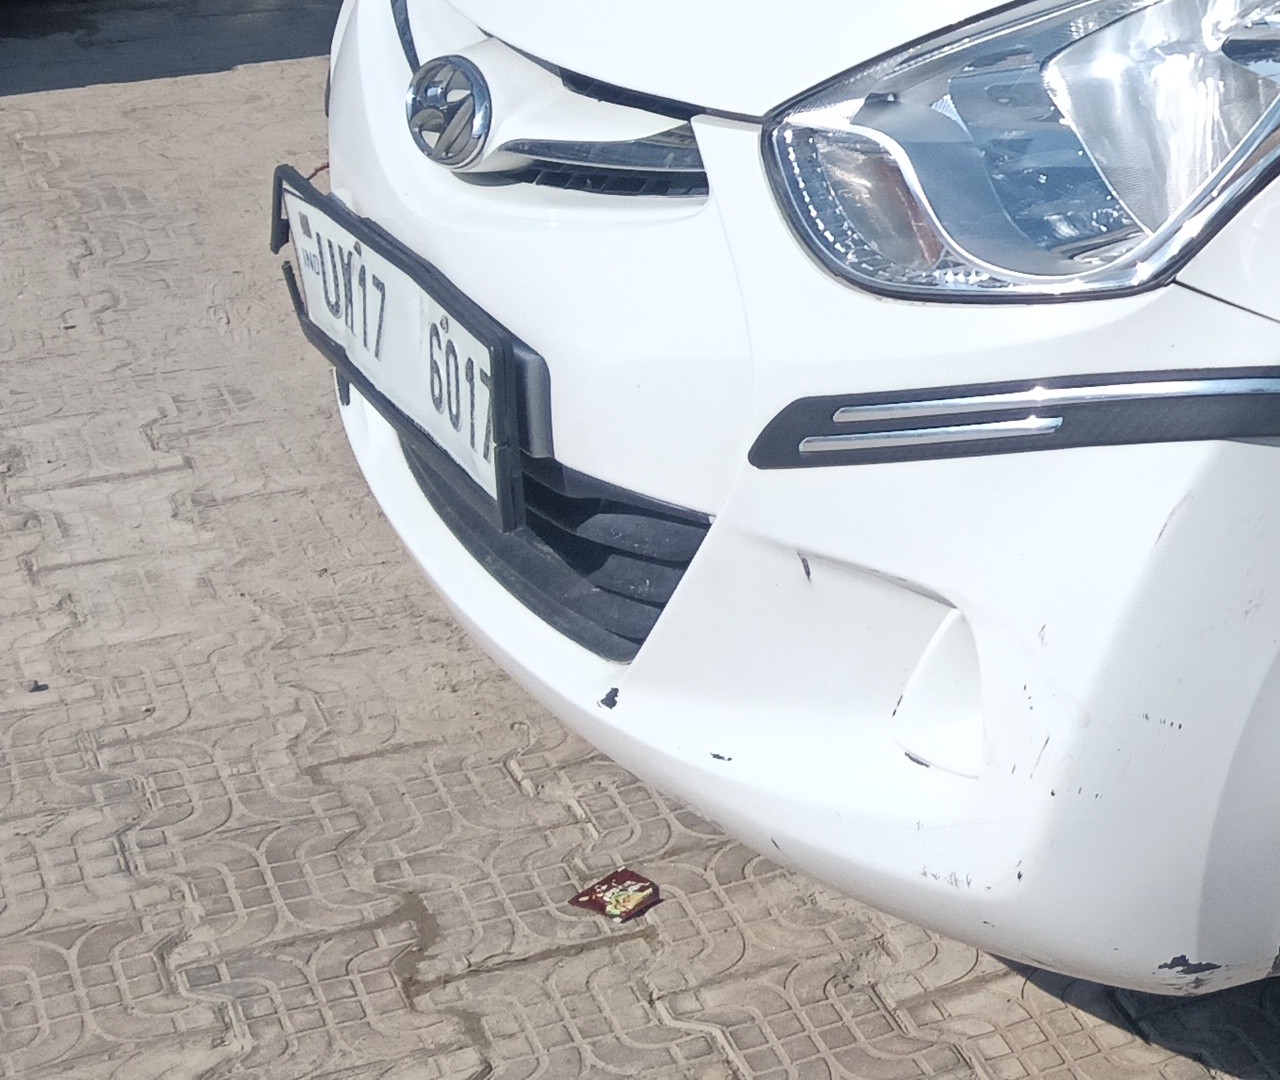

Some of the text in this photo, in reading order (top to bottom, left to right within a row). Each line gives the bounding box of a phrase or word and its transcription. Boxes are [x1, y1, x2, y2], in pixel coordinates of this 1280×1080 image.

[302, 247, 320, 276] IND
[316, 231, 494, 464] UK17 6017
